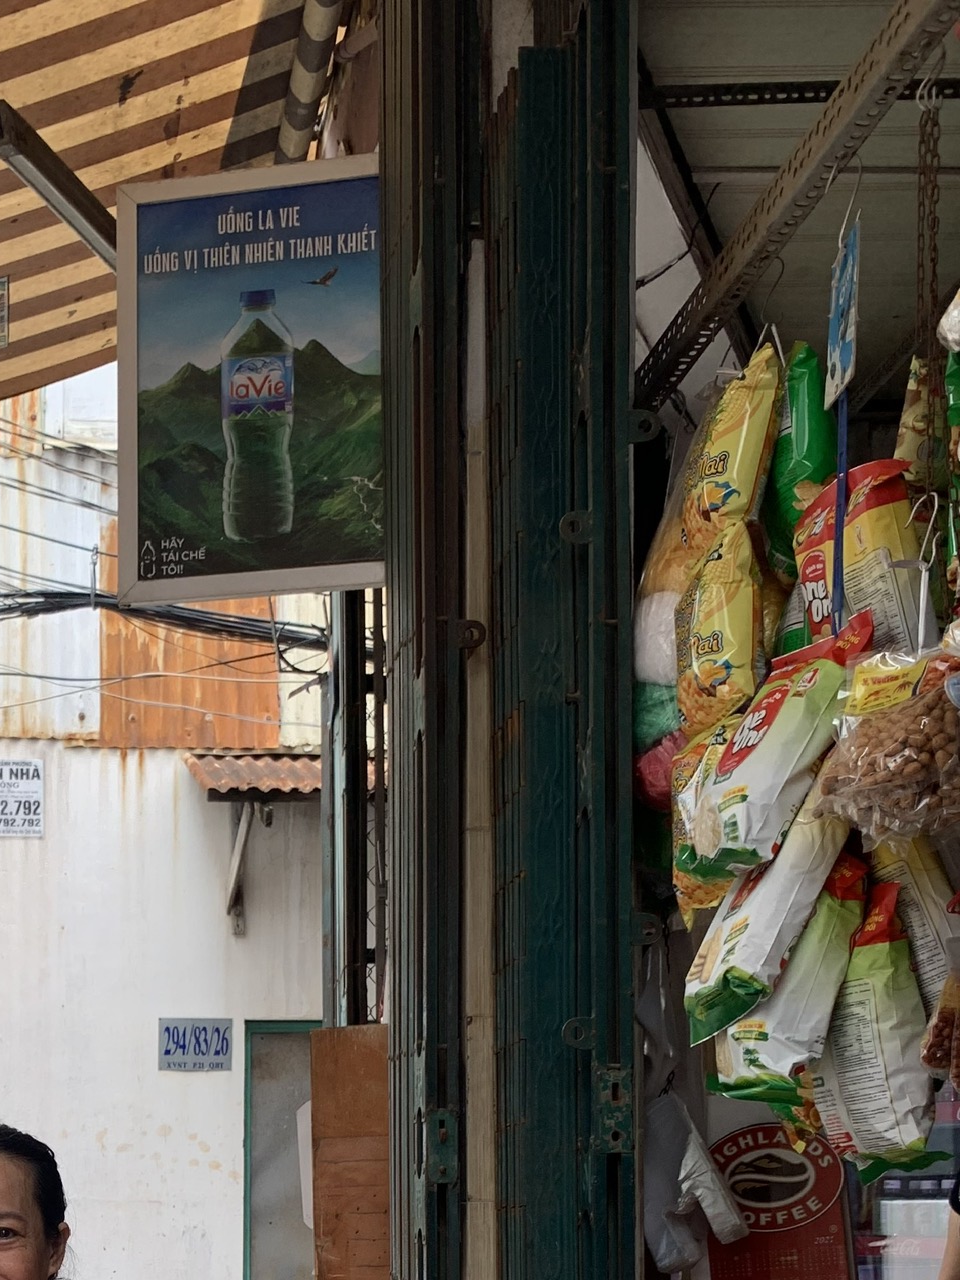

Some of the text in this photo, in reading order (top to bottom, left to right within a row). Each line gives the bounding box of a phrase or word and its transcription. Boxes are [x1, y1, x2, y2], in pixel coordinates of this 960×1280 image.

[217, 206, 301, 235] UỐNG LA VIE
[143, 223, 377, 274] UỐNG VỊ THIÊN NHIÊN THANH KHIẾT
[229, 374, 285, 399] laVie
[161, 536, 185, 549] HÃY
[161, 546, 206, 562] TÁI CHẾ
[161, 563, 184, 575] TÔI!
[9, 764, 41, 781] NHÀ
[163, 1024, 230, 1056] 294/83/26
[713, 1130, 833, 1169] IGHLADS
[742, 1196, 823, 1226] OFFEE
